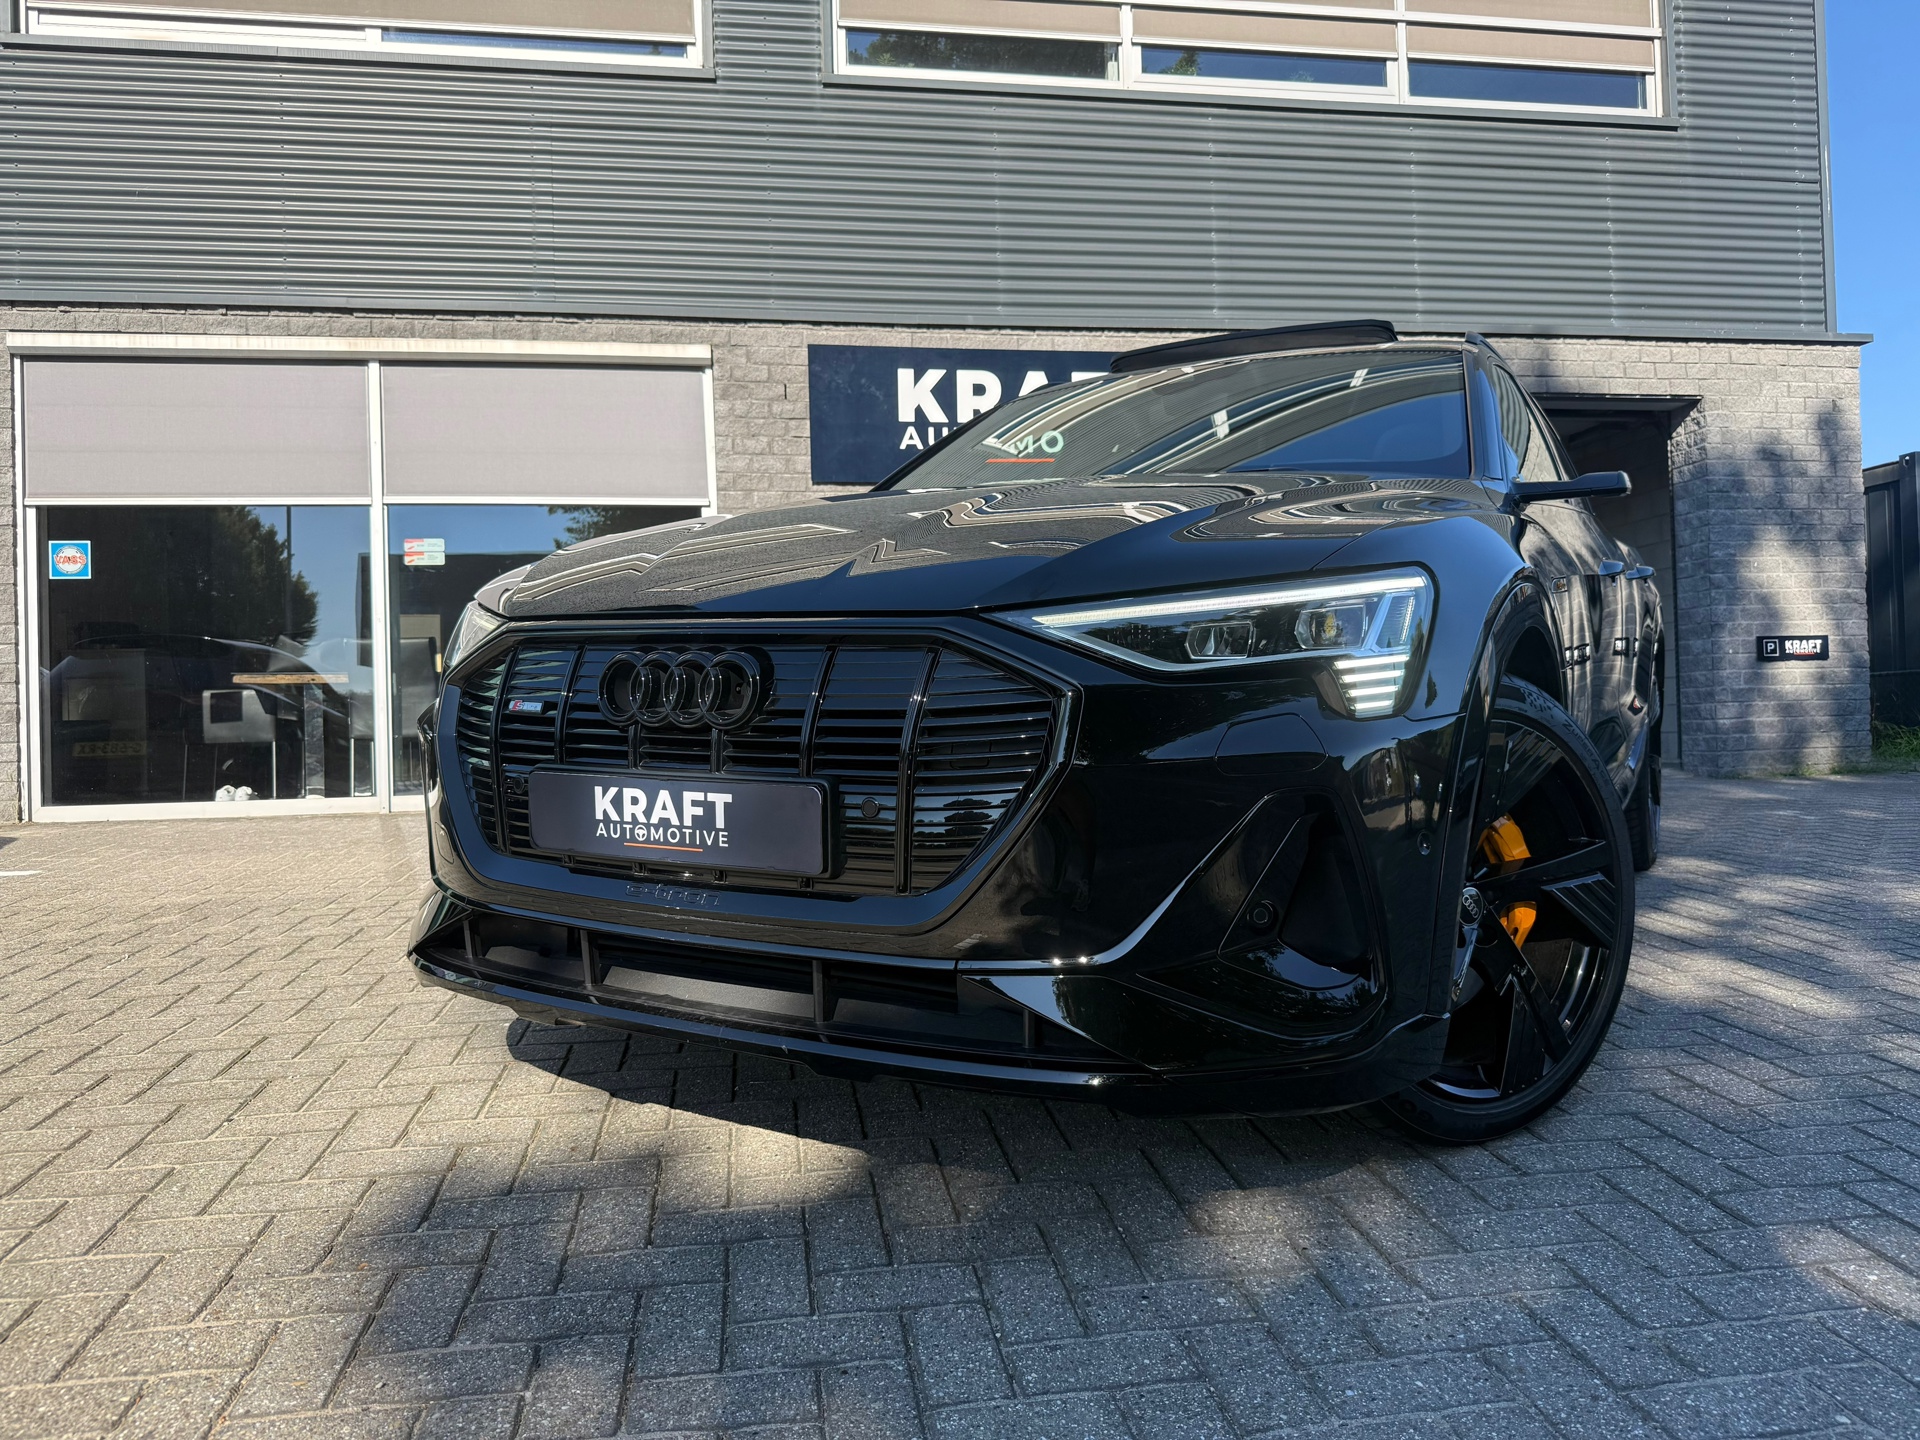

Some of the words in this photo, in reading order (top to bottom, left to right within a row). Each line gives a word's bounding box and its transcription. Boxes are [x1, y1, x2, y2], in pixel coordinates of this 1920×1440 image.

[1784, 640, 1822, 650] KRAFT
[594, 786, 733, 829] KRAFT
[596, 822, 729, 848] AUTOMOTIVE
[625, 883, 720, 906] e-tron
